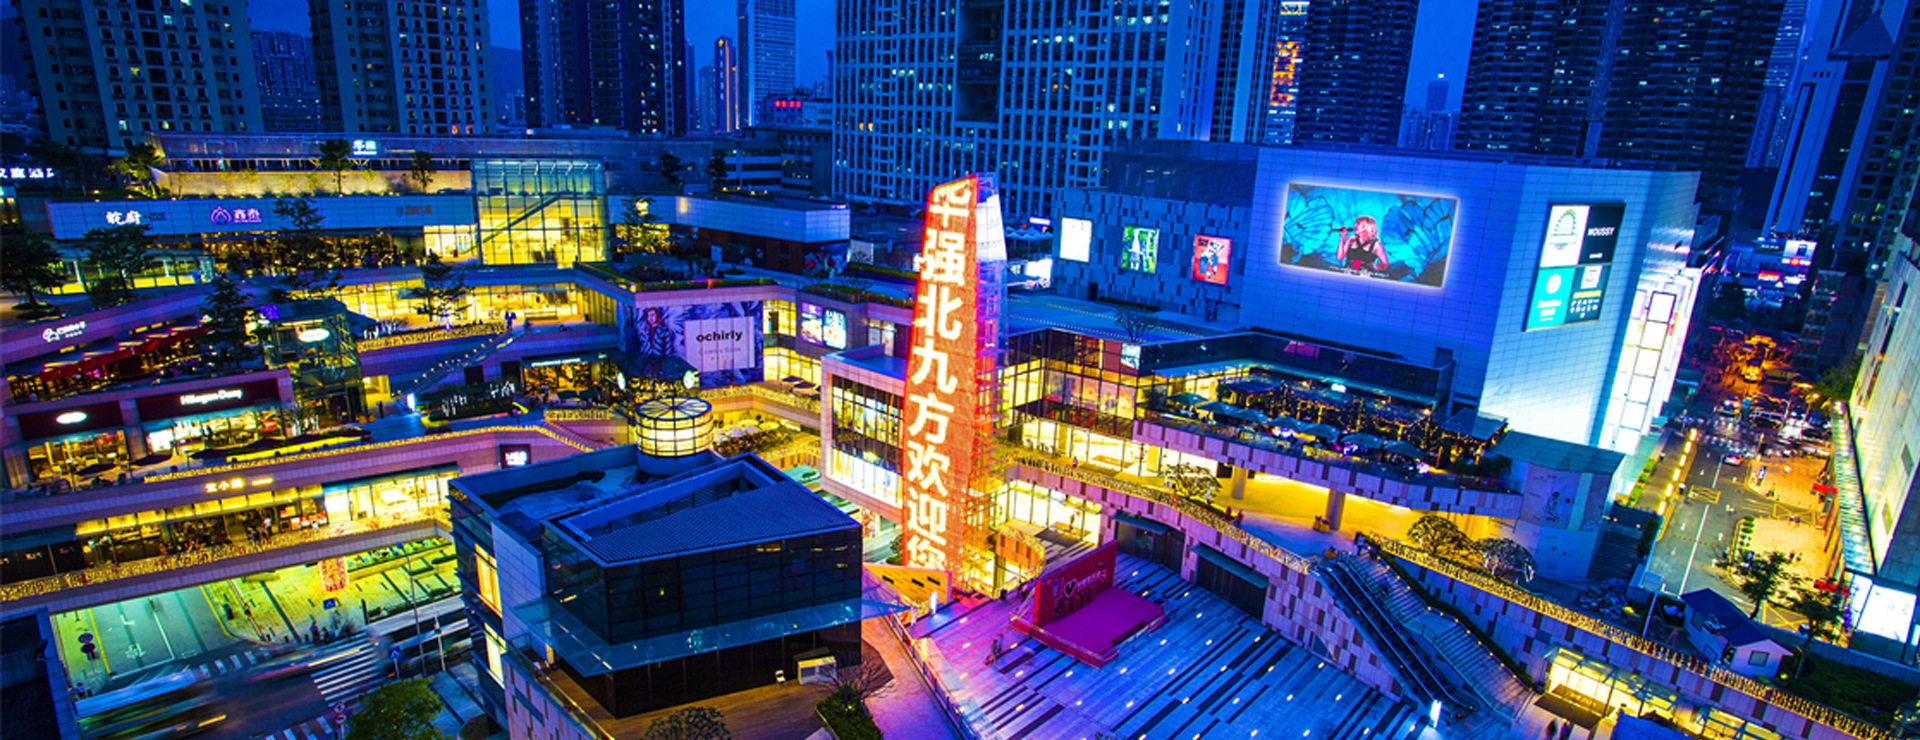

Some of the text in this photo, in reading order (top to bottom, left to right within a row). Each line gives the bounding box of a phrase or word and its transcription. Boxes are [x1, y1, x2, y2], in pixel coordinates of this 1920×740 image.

[1588, 227, 1615, 236] MOUSSY
[696, 330, 743, 342] ochirly
[907, 180, 971, 569] 华强北九方欢迎你
